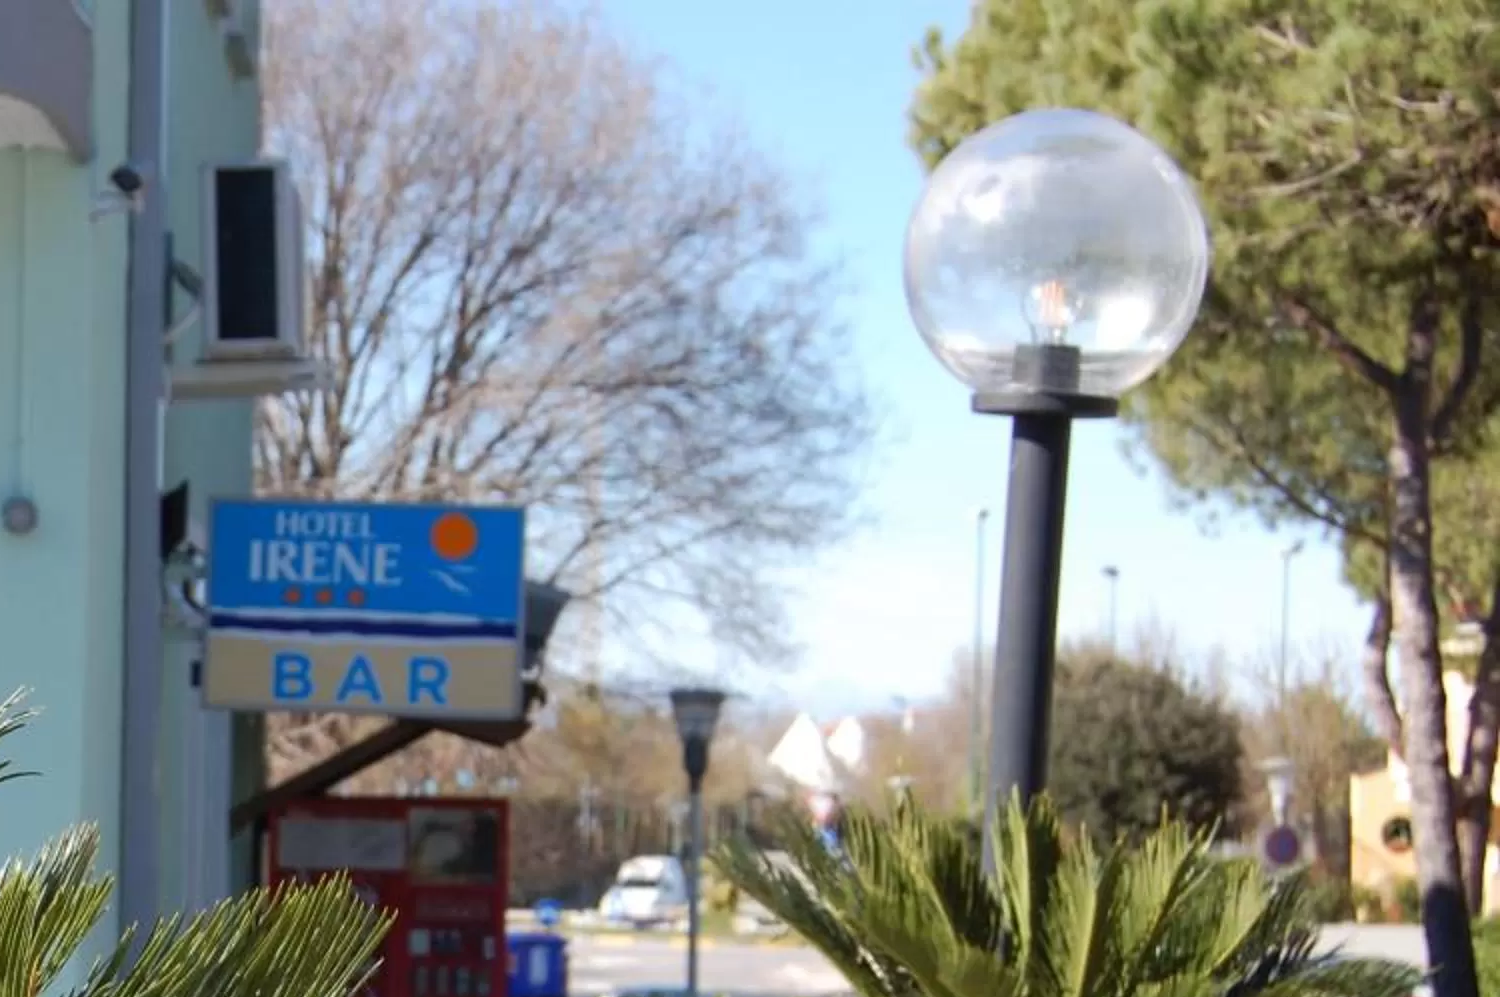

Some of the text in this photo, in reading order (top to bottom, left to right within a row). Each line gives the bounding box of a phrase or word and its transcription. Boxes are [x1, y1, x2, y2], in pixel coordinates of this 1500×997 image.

[275, 510, 376, 538] HOTEL
[249, 539, 404, 585] IRENE
[272, 653, 451, 705] BAR
